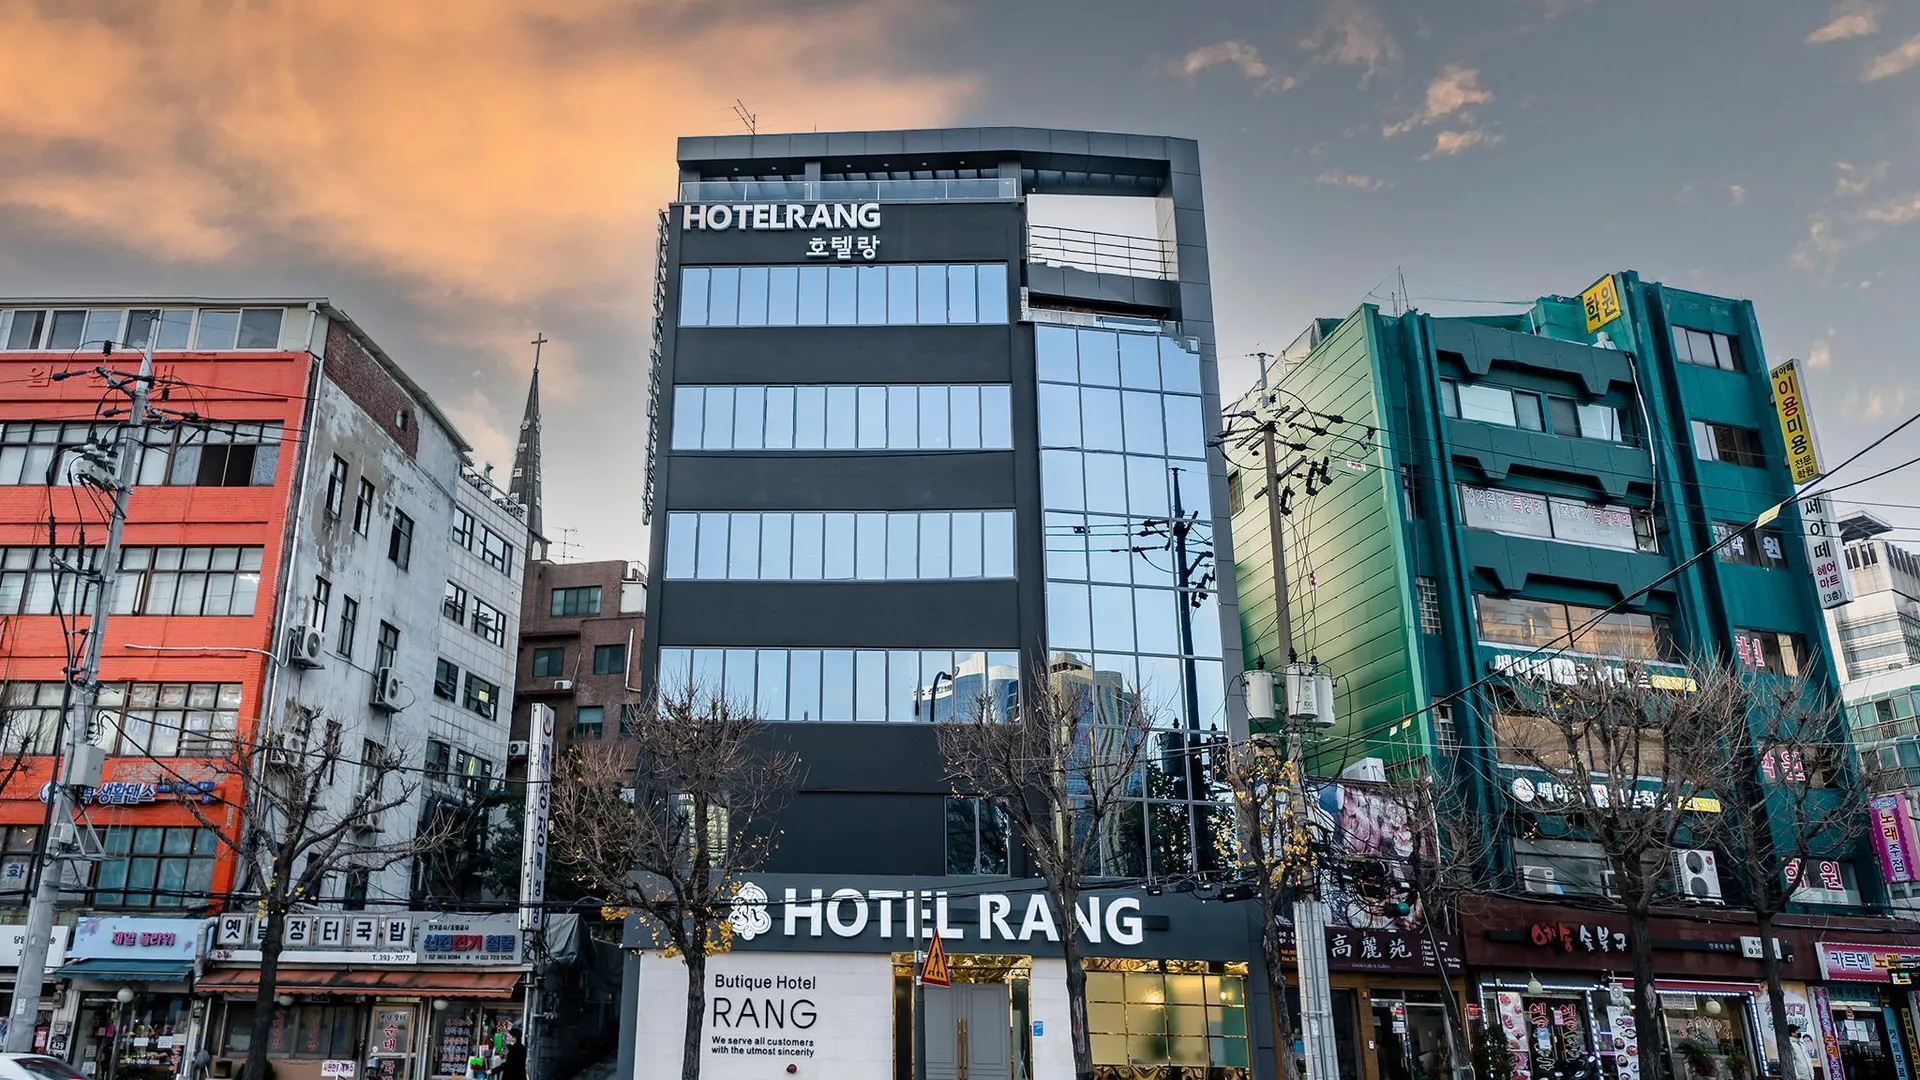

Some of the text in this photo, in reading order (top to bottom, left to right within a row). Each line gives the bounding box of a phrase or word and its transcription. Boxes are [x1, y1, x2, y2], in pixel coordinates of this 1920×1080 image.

[682, 203, 881, 230] HOTELRANG
[806, 235, 880, 260] 호텔랑
[1586, 282, 1617, 322] 학원
[1778, 376, 1807, 455] 이용미용
[1817, 561, 1836, 576] 헤어
[1820, 575, 1840, 589] 마트
[1823, 589, 1842, 603] (3층)
[1880, 813, 1905, 873] 노래주점
[784, 888, 1144, 945] HOTEL RANG
[1331, 933, 1413, 959] 高麗苑
[1829, 951, 1873, 972] 카르멘
[715, 974, 816, 991] Butique Hotel
[713, 997, 817, 1029] RANG
[711, 1046, 814, 1058] with the utmost sincerity
[712, 1036, 814, 1047] We serve all customers
